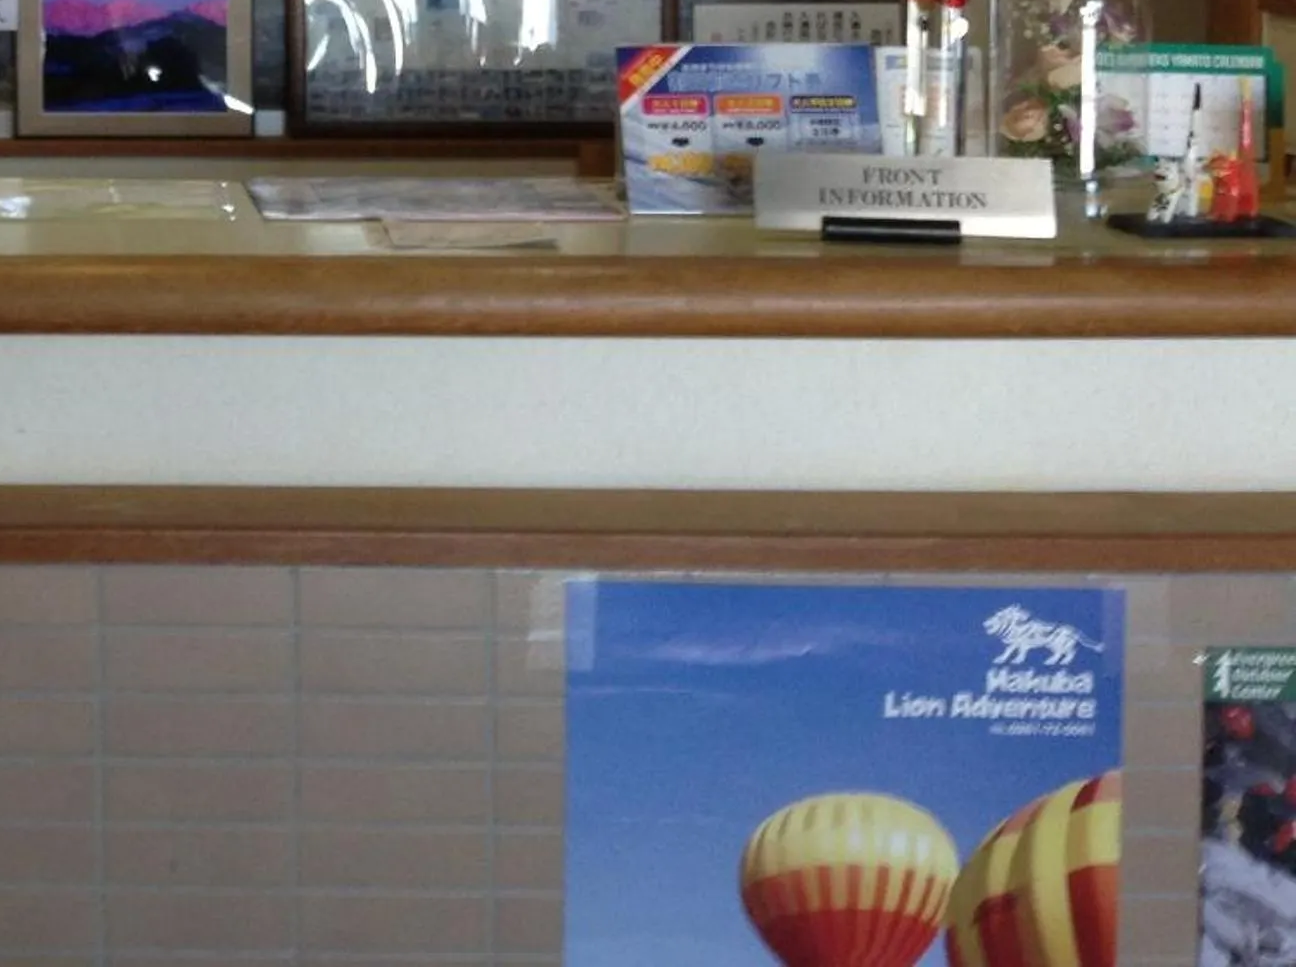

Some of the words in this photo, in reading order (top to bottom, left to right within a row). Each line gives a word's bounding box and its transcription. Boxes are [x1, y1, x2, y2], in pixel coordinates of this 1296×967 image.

[862, 165, 943, 186] FRONT
[818, 186, 988, 209] INFORMATION
[985, 666, 1095, 694] Hakuba
[883, 691, 947, 718] Lion
[950, 692, 1098, 719] Adventure
